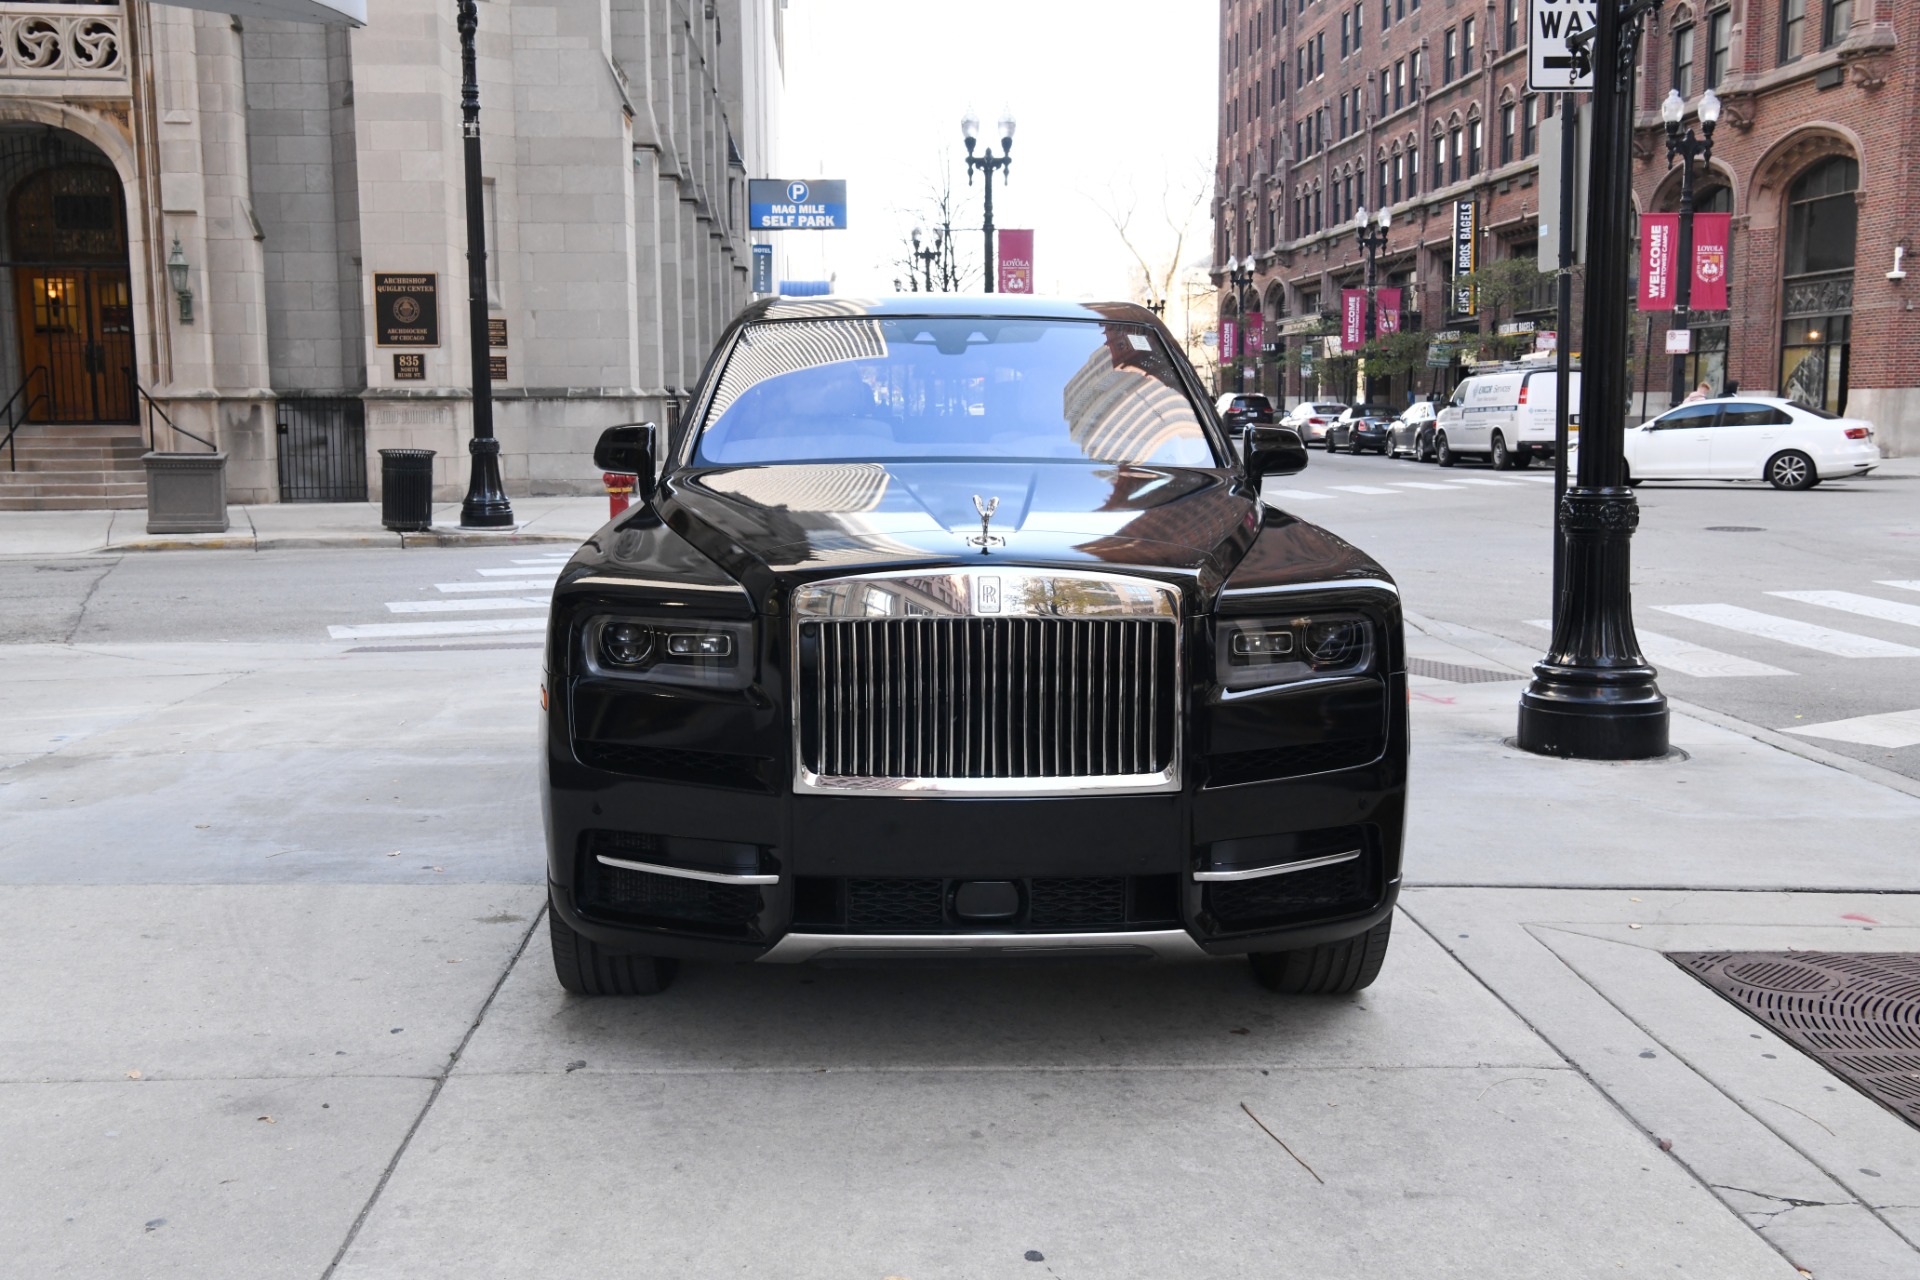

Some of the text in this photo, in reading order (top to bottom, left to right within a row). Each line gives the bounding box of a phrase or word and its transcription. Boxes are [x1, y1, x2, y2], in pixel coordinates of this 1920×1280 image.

[792, 184, 805, 200] P
[771, 205, 825, 214] MAG MILE
[761, 215, 835, 227] SELF PARK
[1460, 203, 1472, 240] BAGELS
[1002, 259, 1030, 267] LOYOLA
[1648, 225, 1661, 298] WELCOME
[377, 285, 406, 293] QUIGLEY
[1347, 296, 1355, 343] WELCOME
[399, 355, 419, 367] 835
